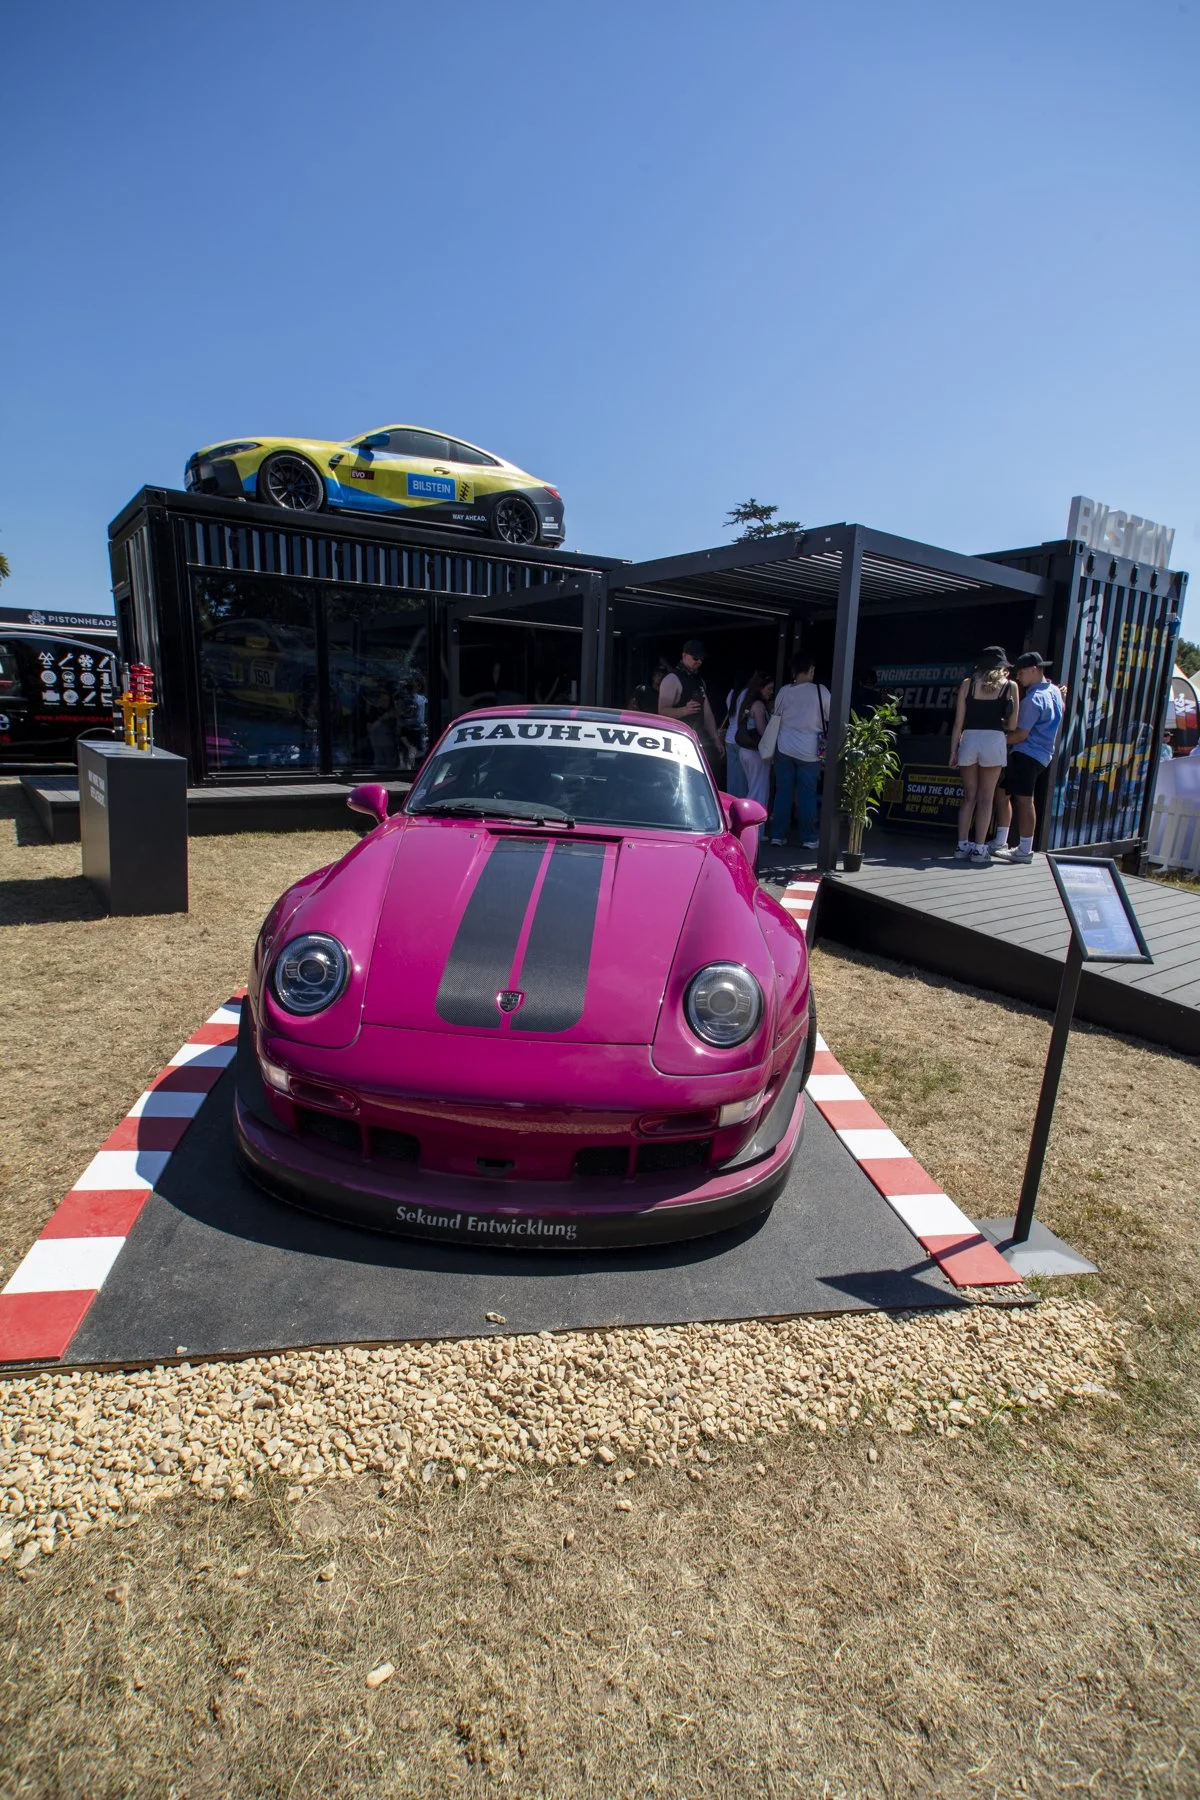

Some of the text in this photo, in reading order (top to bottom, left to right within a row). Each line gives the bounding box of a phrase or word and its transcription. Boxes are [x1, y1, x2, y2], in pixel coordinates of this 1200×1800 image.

[351, 470, 366, 479] EVO
[412, 479, 451, 494] BILSTEIN
[48, 615, 117, 627] PISTONHEADS
[876, 668, 941, 682] ENGINEERED
[454, 723, 686, 757] RAUH-Wel
[907, 784, 927, 794] SCAN
[928, 785, 944, 795] THE
[396, 1206, 577, 1240] Sekund Entwicklung
